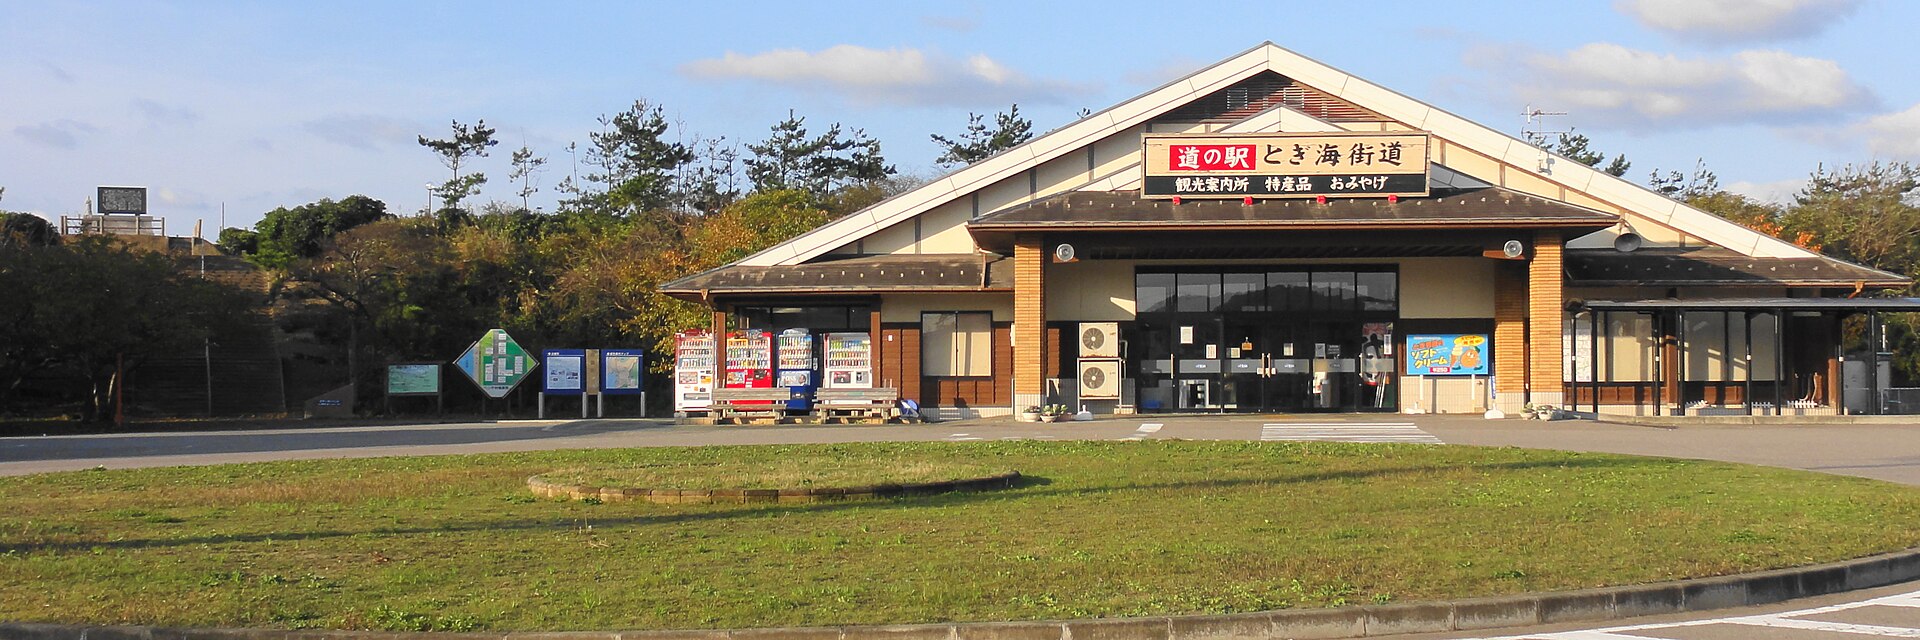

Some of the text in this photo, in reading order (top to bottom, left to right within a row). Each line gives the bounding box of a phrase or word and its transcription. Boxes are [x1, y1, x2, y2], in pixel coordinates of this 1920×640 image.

[1177, 141, 1404, 170] 道の駅 とぎ海街道
[1175, 176, 1389, 193] 観光案内所 特産品 おみやげ
[1411, 349, 1437, 360] ソフト
[1414, 356, 1448, 369] クリーム
